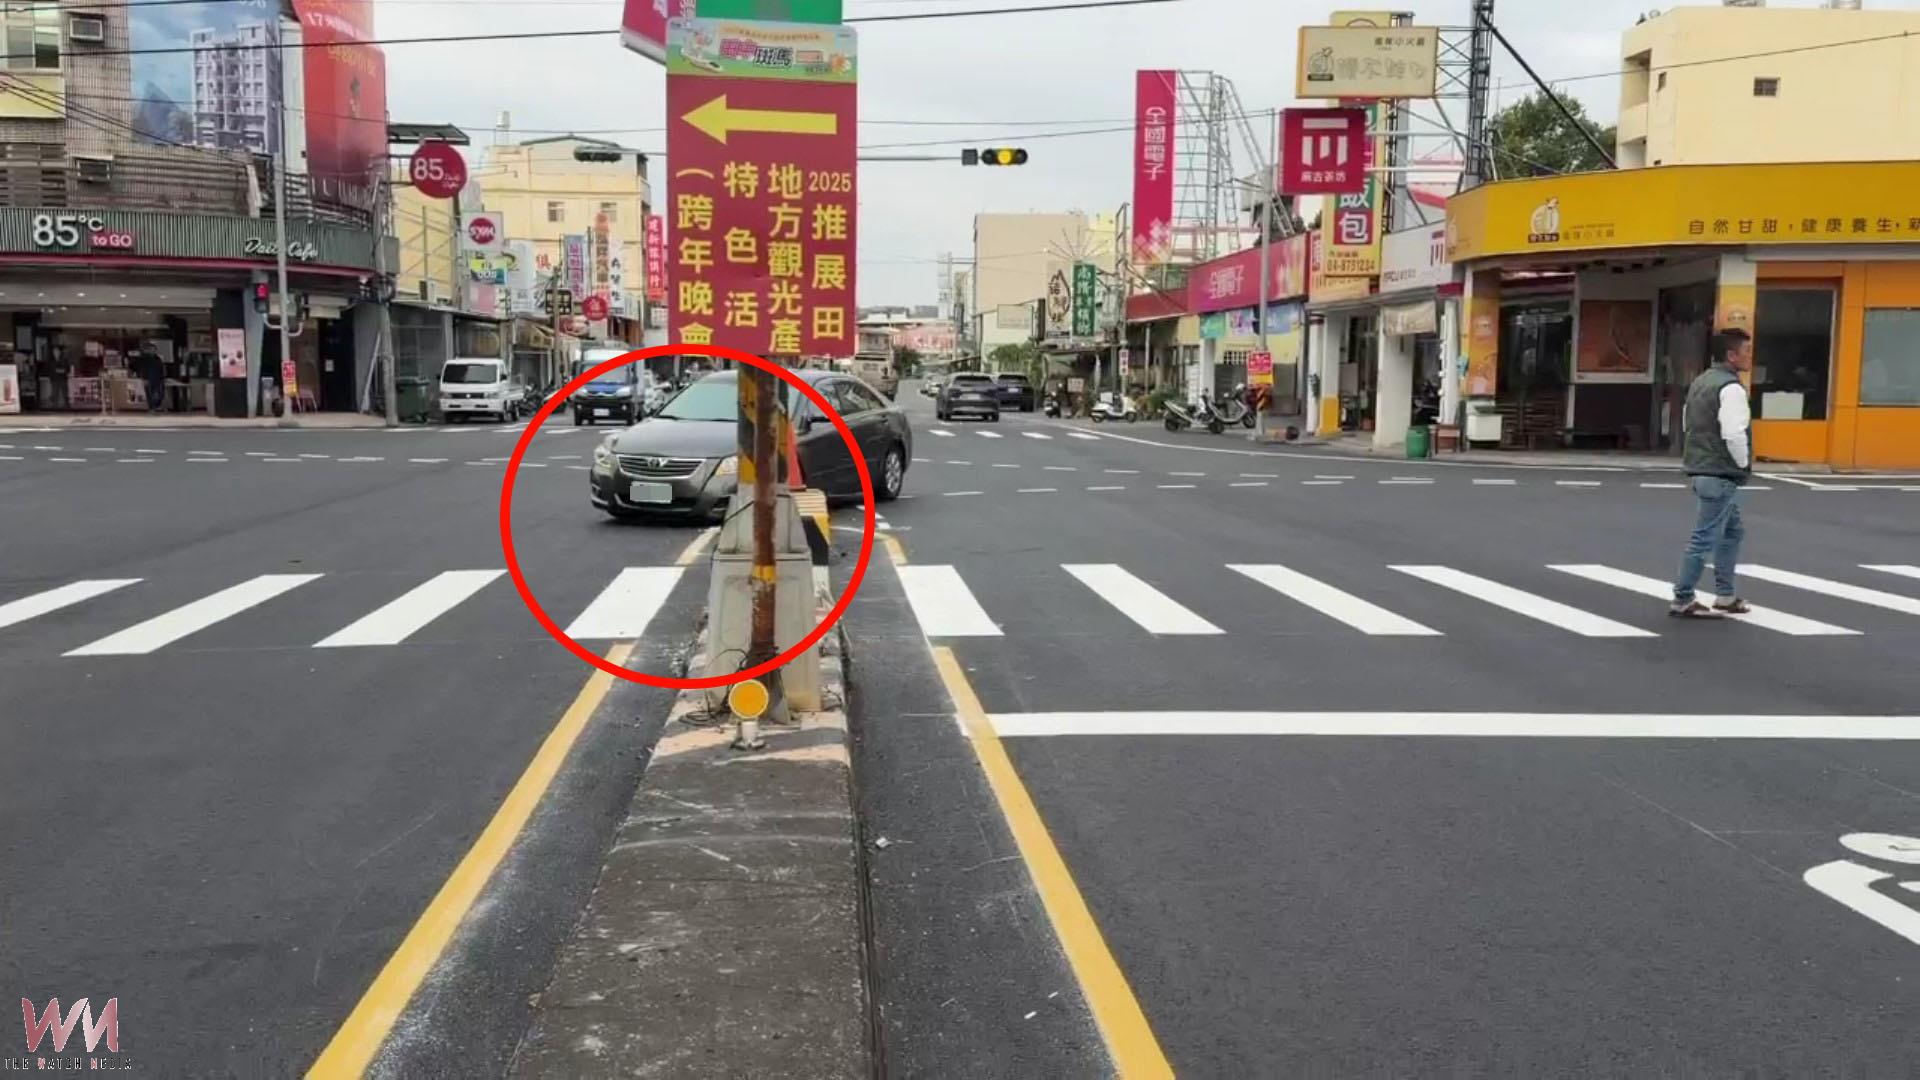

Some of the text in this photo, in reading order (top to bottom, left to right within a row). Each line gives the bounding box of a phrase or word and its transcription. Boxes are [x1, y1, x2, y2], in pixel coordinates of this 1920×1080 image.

[414, 158, 444, 180] 85
[1143, 106, 1167, 181] 全國電子
[33, 214, 104, 246] 85°C
[92, 234, 132, 247] to GO
[723, 161, 759, 328] 特色活
[767, 163, 804, 353] 地方觀光產
[808, 171, 851, 340] 2025 推展田
